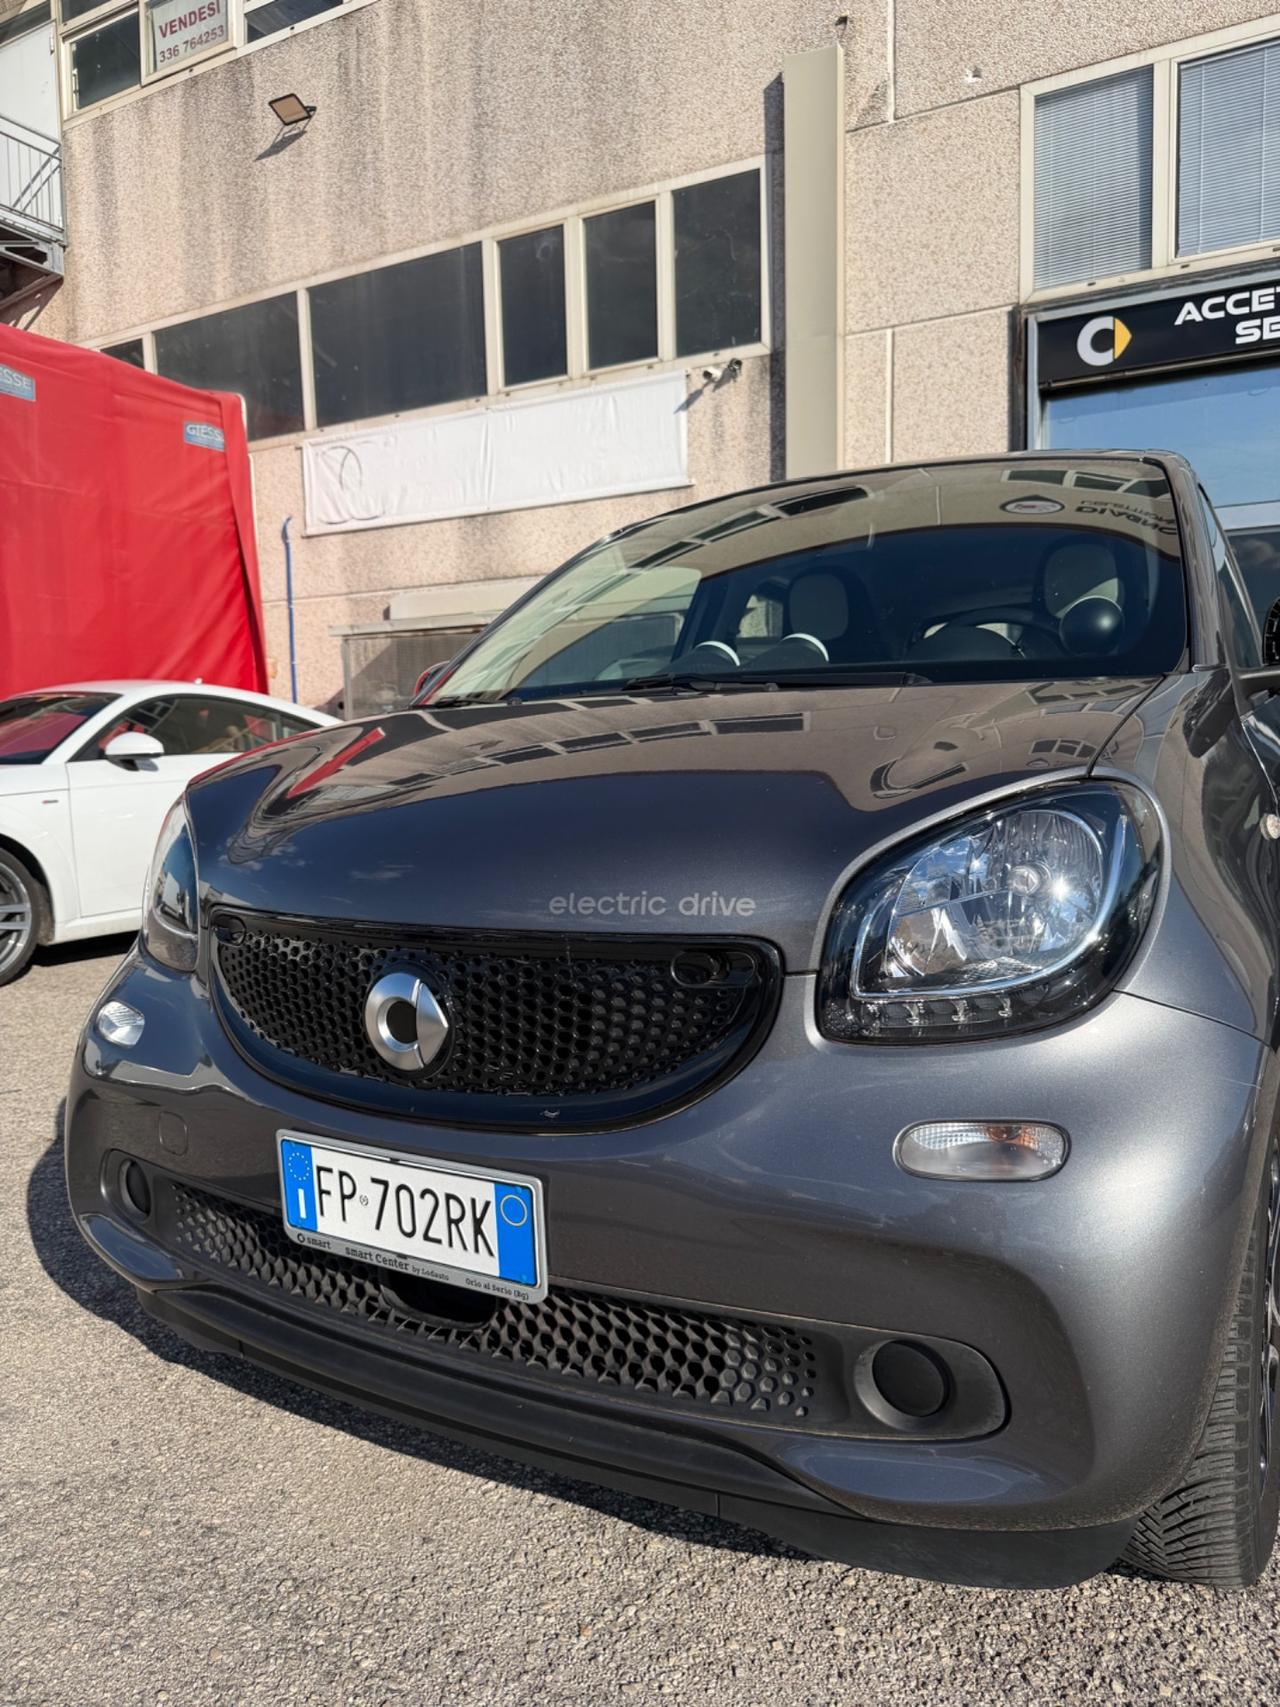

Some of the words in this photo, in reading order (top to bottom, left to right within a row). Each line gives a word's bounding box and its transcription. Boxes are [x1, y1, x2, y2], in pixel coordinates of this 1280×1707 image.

[159, 0, 220, 38] VENDESI
[159, 45, 179, 63] 336
[182, 24, 224, 53] 764253
[1174, 286, 1280, 326] ACCE
[549, 891, 667, 915] electric
[678, 891, 757, 917] drive
[307, 1237, 332, 1250] smart
[345, 1246, 373, 1260] smart
[375, 1253, 410, 1271] Center
[465, 1277, 482, 1288] Orio
[492, 1284, 512, 1296] Serio
